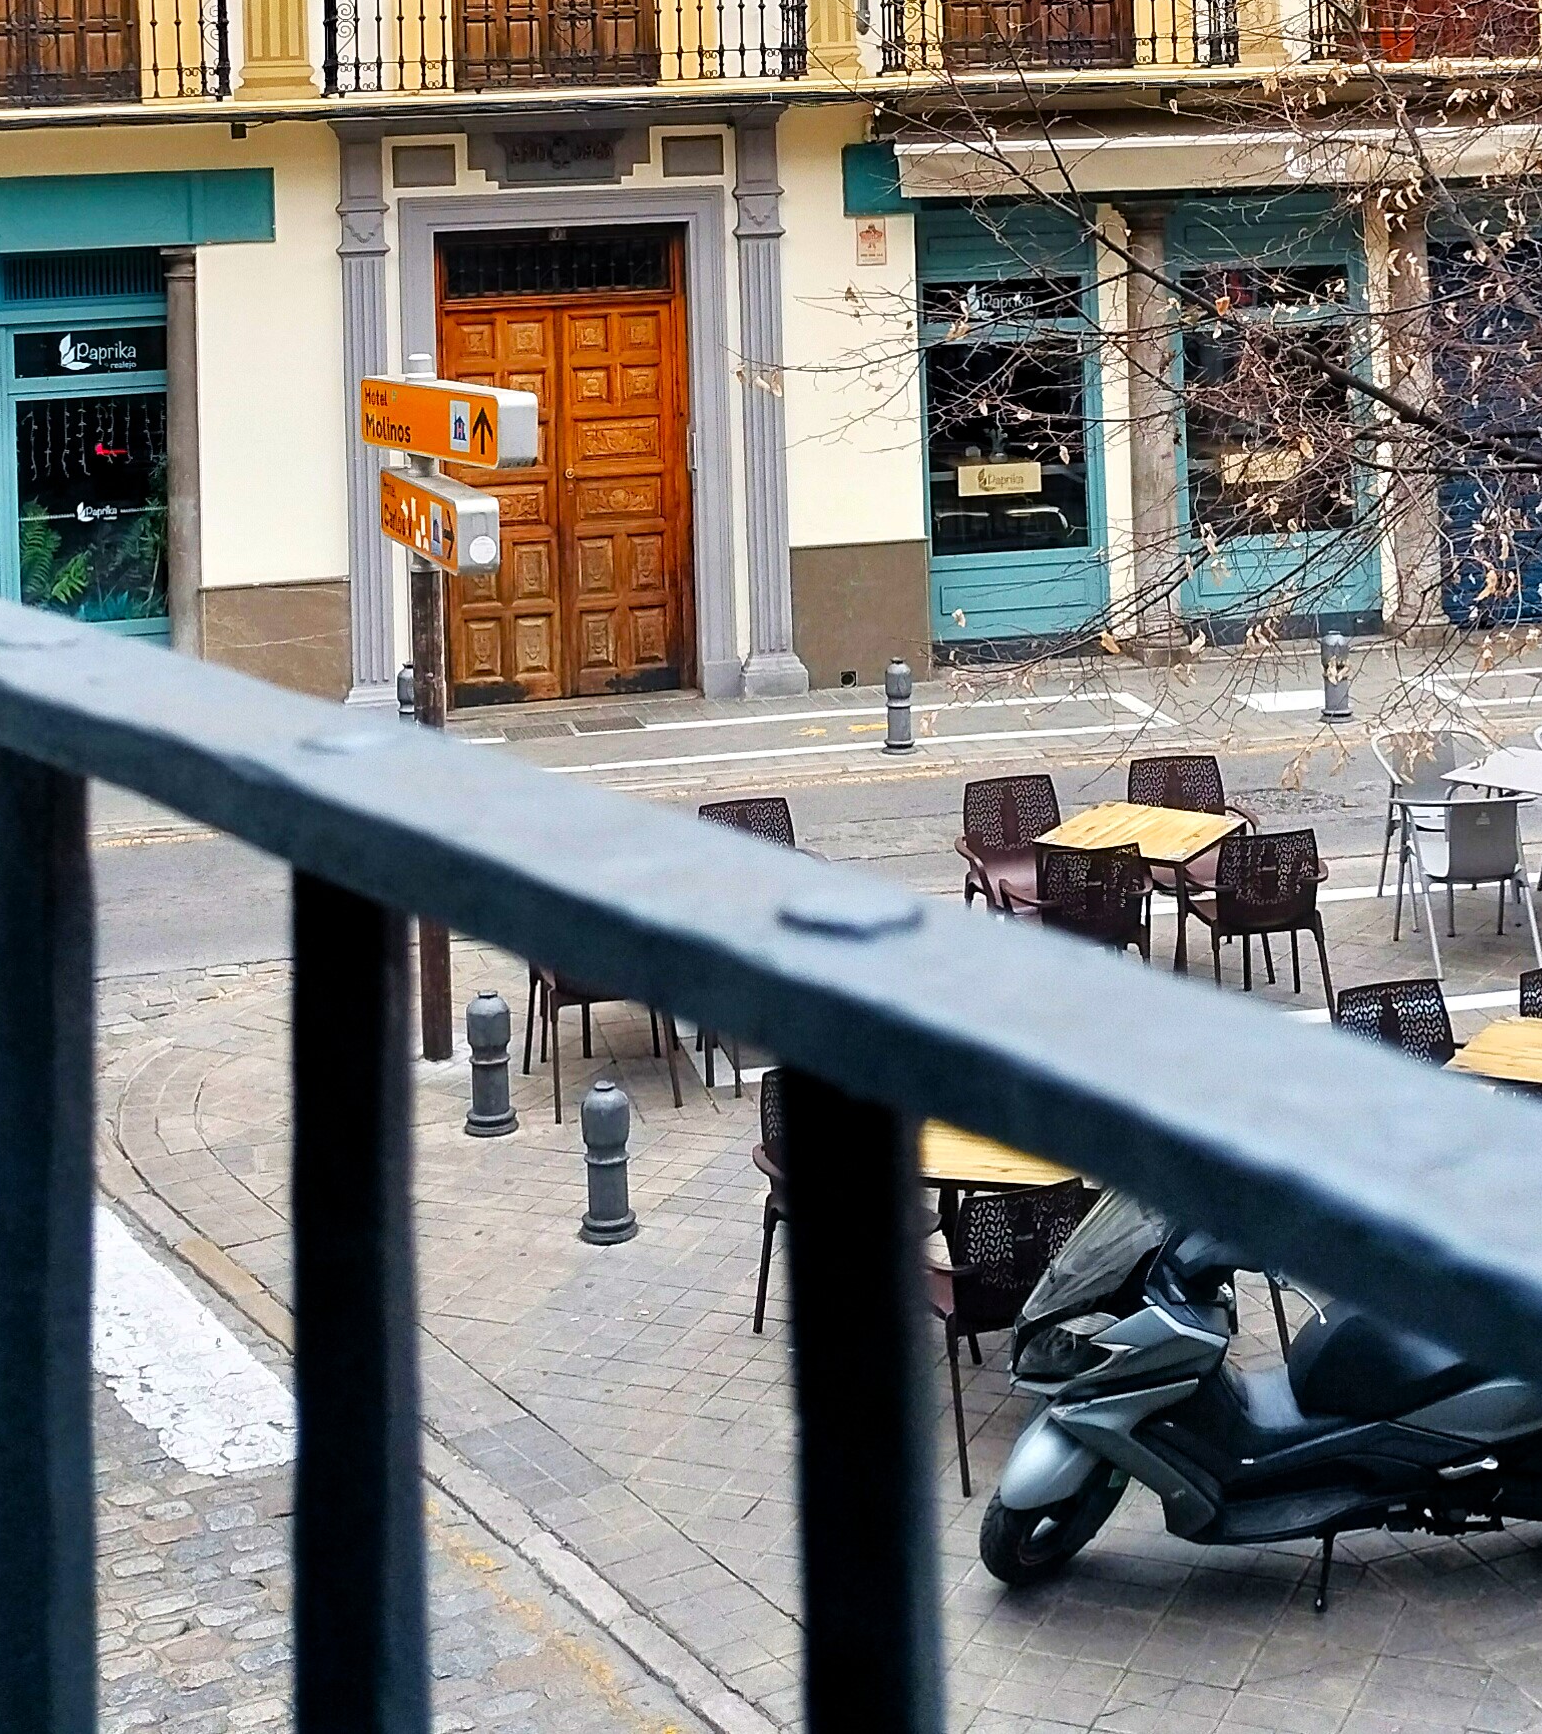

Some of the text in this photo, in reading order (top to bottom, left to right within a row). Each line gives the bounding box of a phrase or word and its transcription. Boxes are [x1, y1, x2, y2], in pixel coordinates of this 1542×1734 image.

[76, 340, 137, 366] Paprika
[364, 387, 389, 407] Hotel
[365, 413, 411, 444] Molinos
